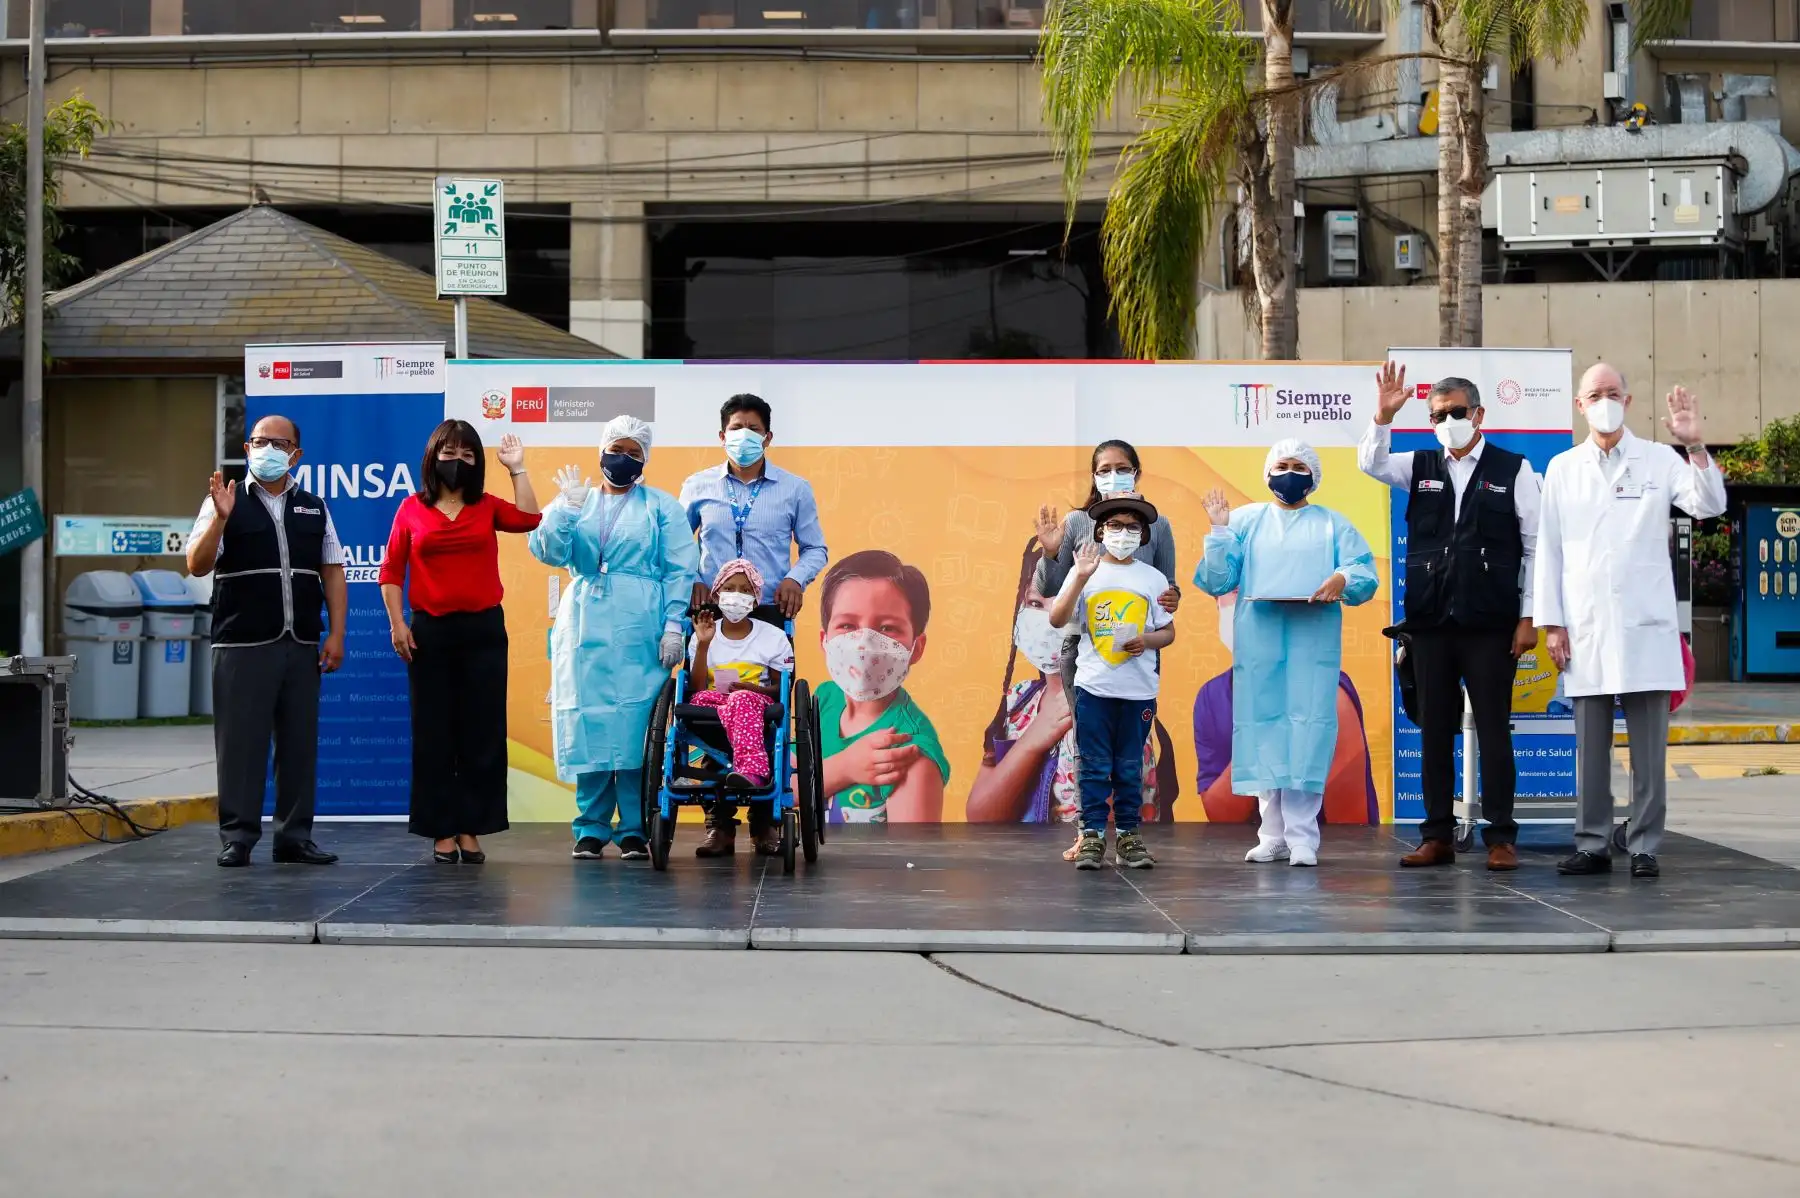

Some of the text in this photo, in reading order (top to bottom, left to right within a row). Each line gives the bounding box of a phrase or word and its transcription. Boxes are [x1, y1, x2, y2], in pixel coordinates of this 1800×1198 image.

[465, 242, 478, 254] 11
[396, 360, 435, 370] Siempre
[410, 369, 435, 377] pueblo
[516, 398, 595, 410] PERÚ Ministerio
[1276, 390, 1352, 409] Siempre
[566, 409, 588, 417] Salud
[1303, 408, 1352, 423] pueblo
[0, 494, 25, 513] PETE
[0, 524, 32, 545] ERDES
[342, 546, 386, 566] ALU
[346, 570, 378, 580] EREC
[349, 608, 385, 616] Minister
[1398, 750, 1422, 758] Minis
[1536, 748, 1547, 756] de
[1549, 748, 1572, 756] Salud
